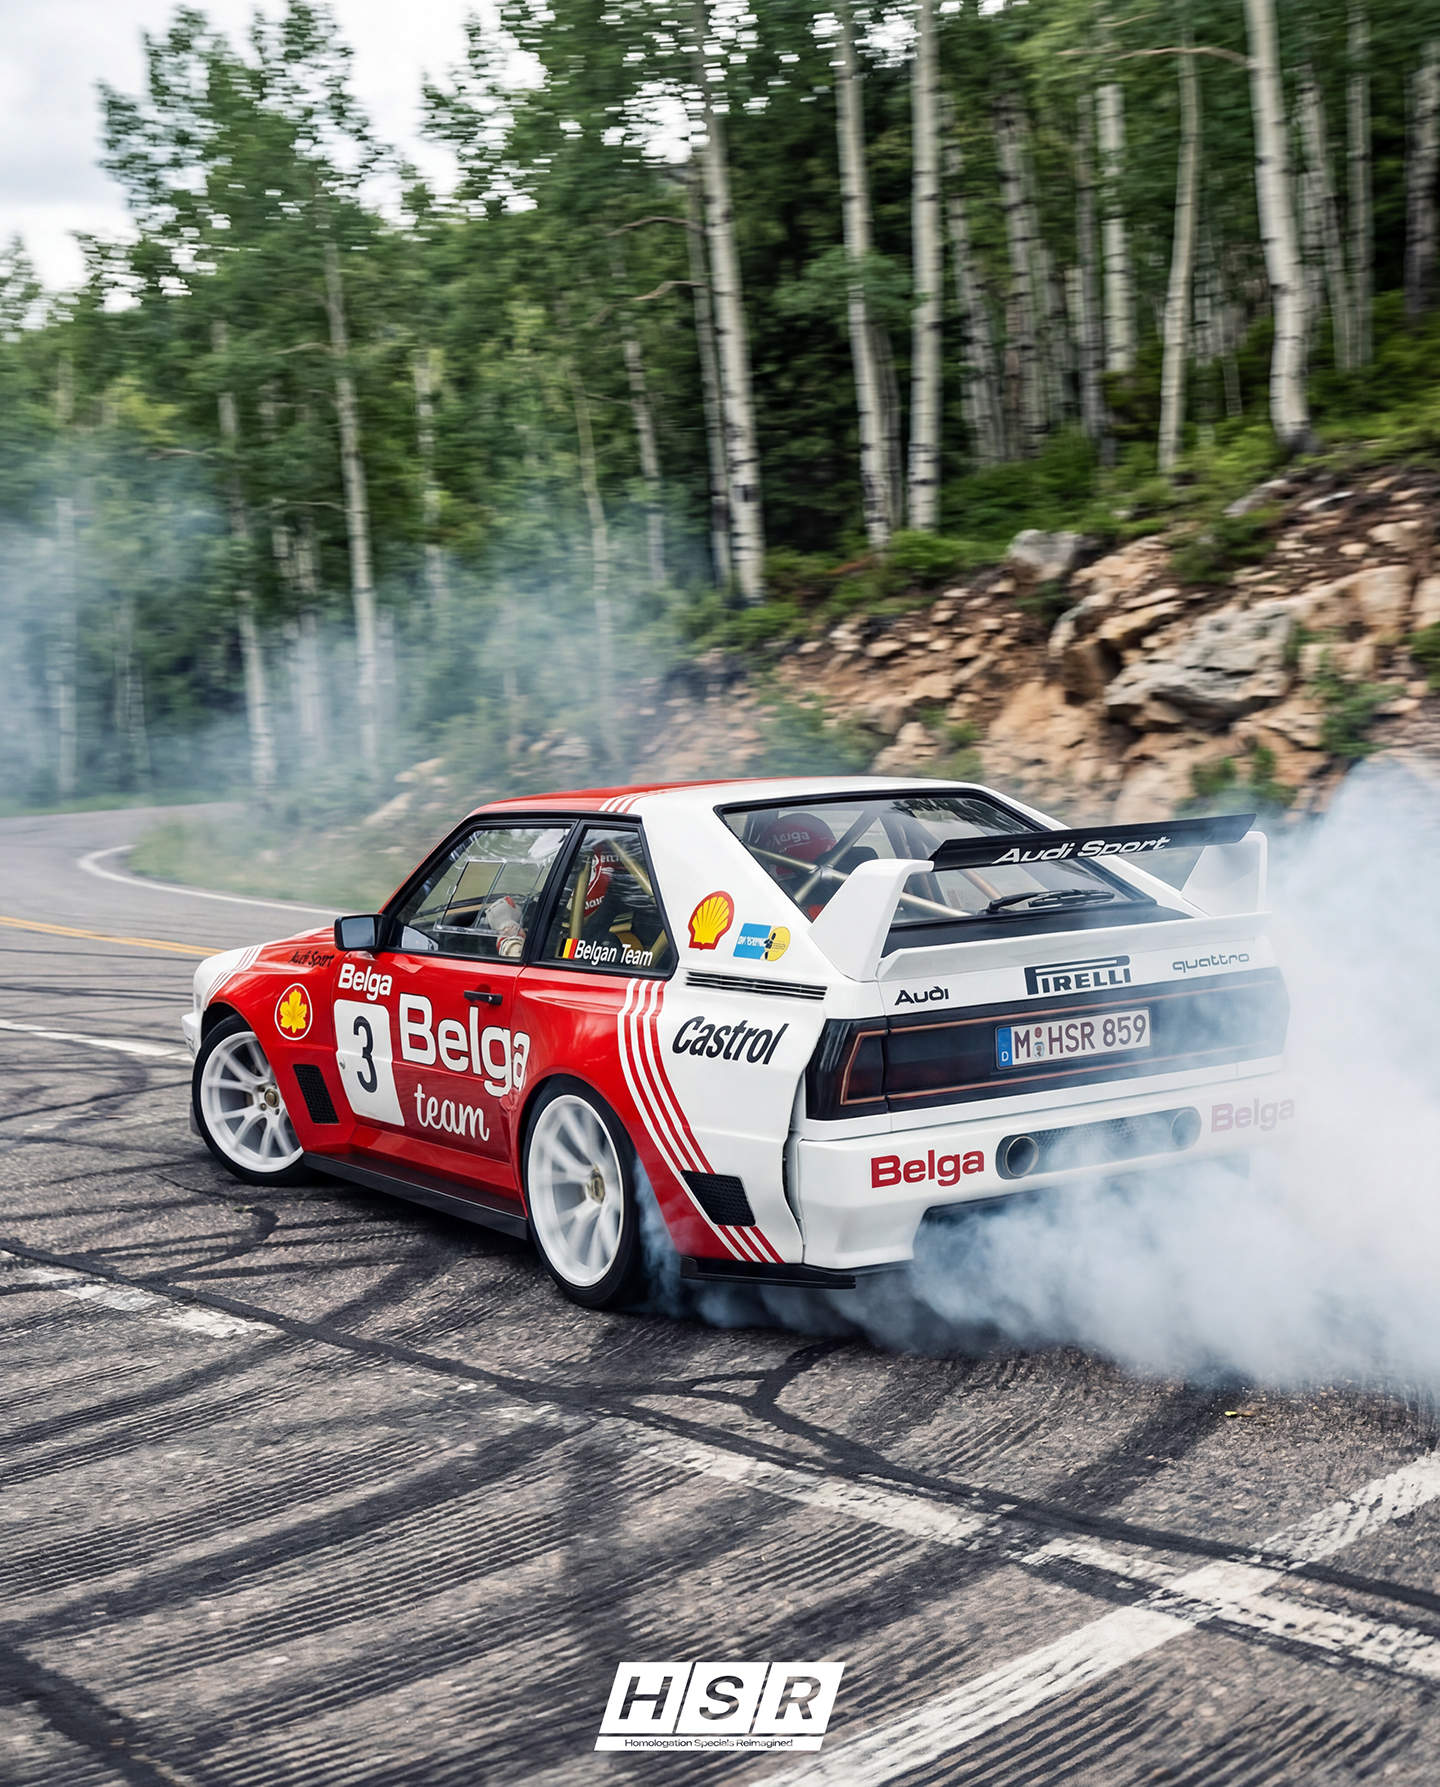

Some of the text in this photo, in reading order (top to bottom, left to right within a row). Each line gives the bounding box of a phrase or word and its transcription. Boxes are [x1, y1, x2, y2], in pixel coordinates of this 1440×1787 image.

[992, 835, 1171, 865] Audi Sport
[574, 940, 653, 967] Belgan Team
[1172, 951, 1250, 972] quattro
[338, 963, 393, 1001] Belga
[1024, 955, 1131, 995] PIRELLI
[894, 986, 949, 1006] Audi
[353, 1015, 378, 1093] 3
[400, 993, 530, 1097] Belga
[672, 1015, 790, 1065] Castrol
[1014, 1014, 1146, 1059] M HSR 859
[1001, 1051, 1009, 1062] D
[413, 1083, 490, 1141] team
[1211, 1097, 1295, 1133] Belga
[870, 1149, 985, 1188] Belga
